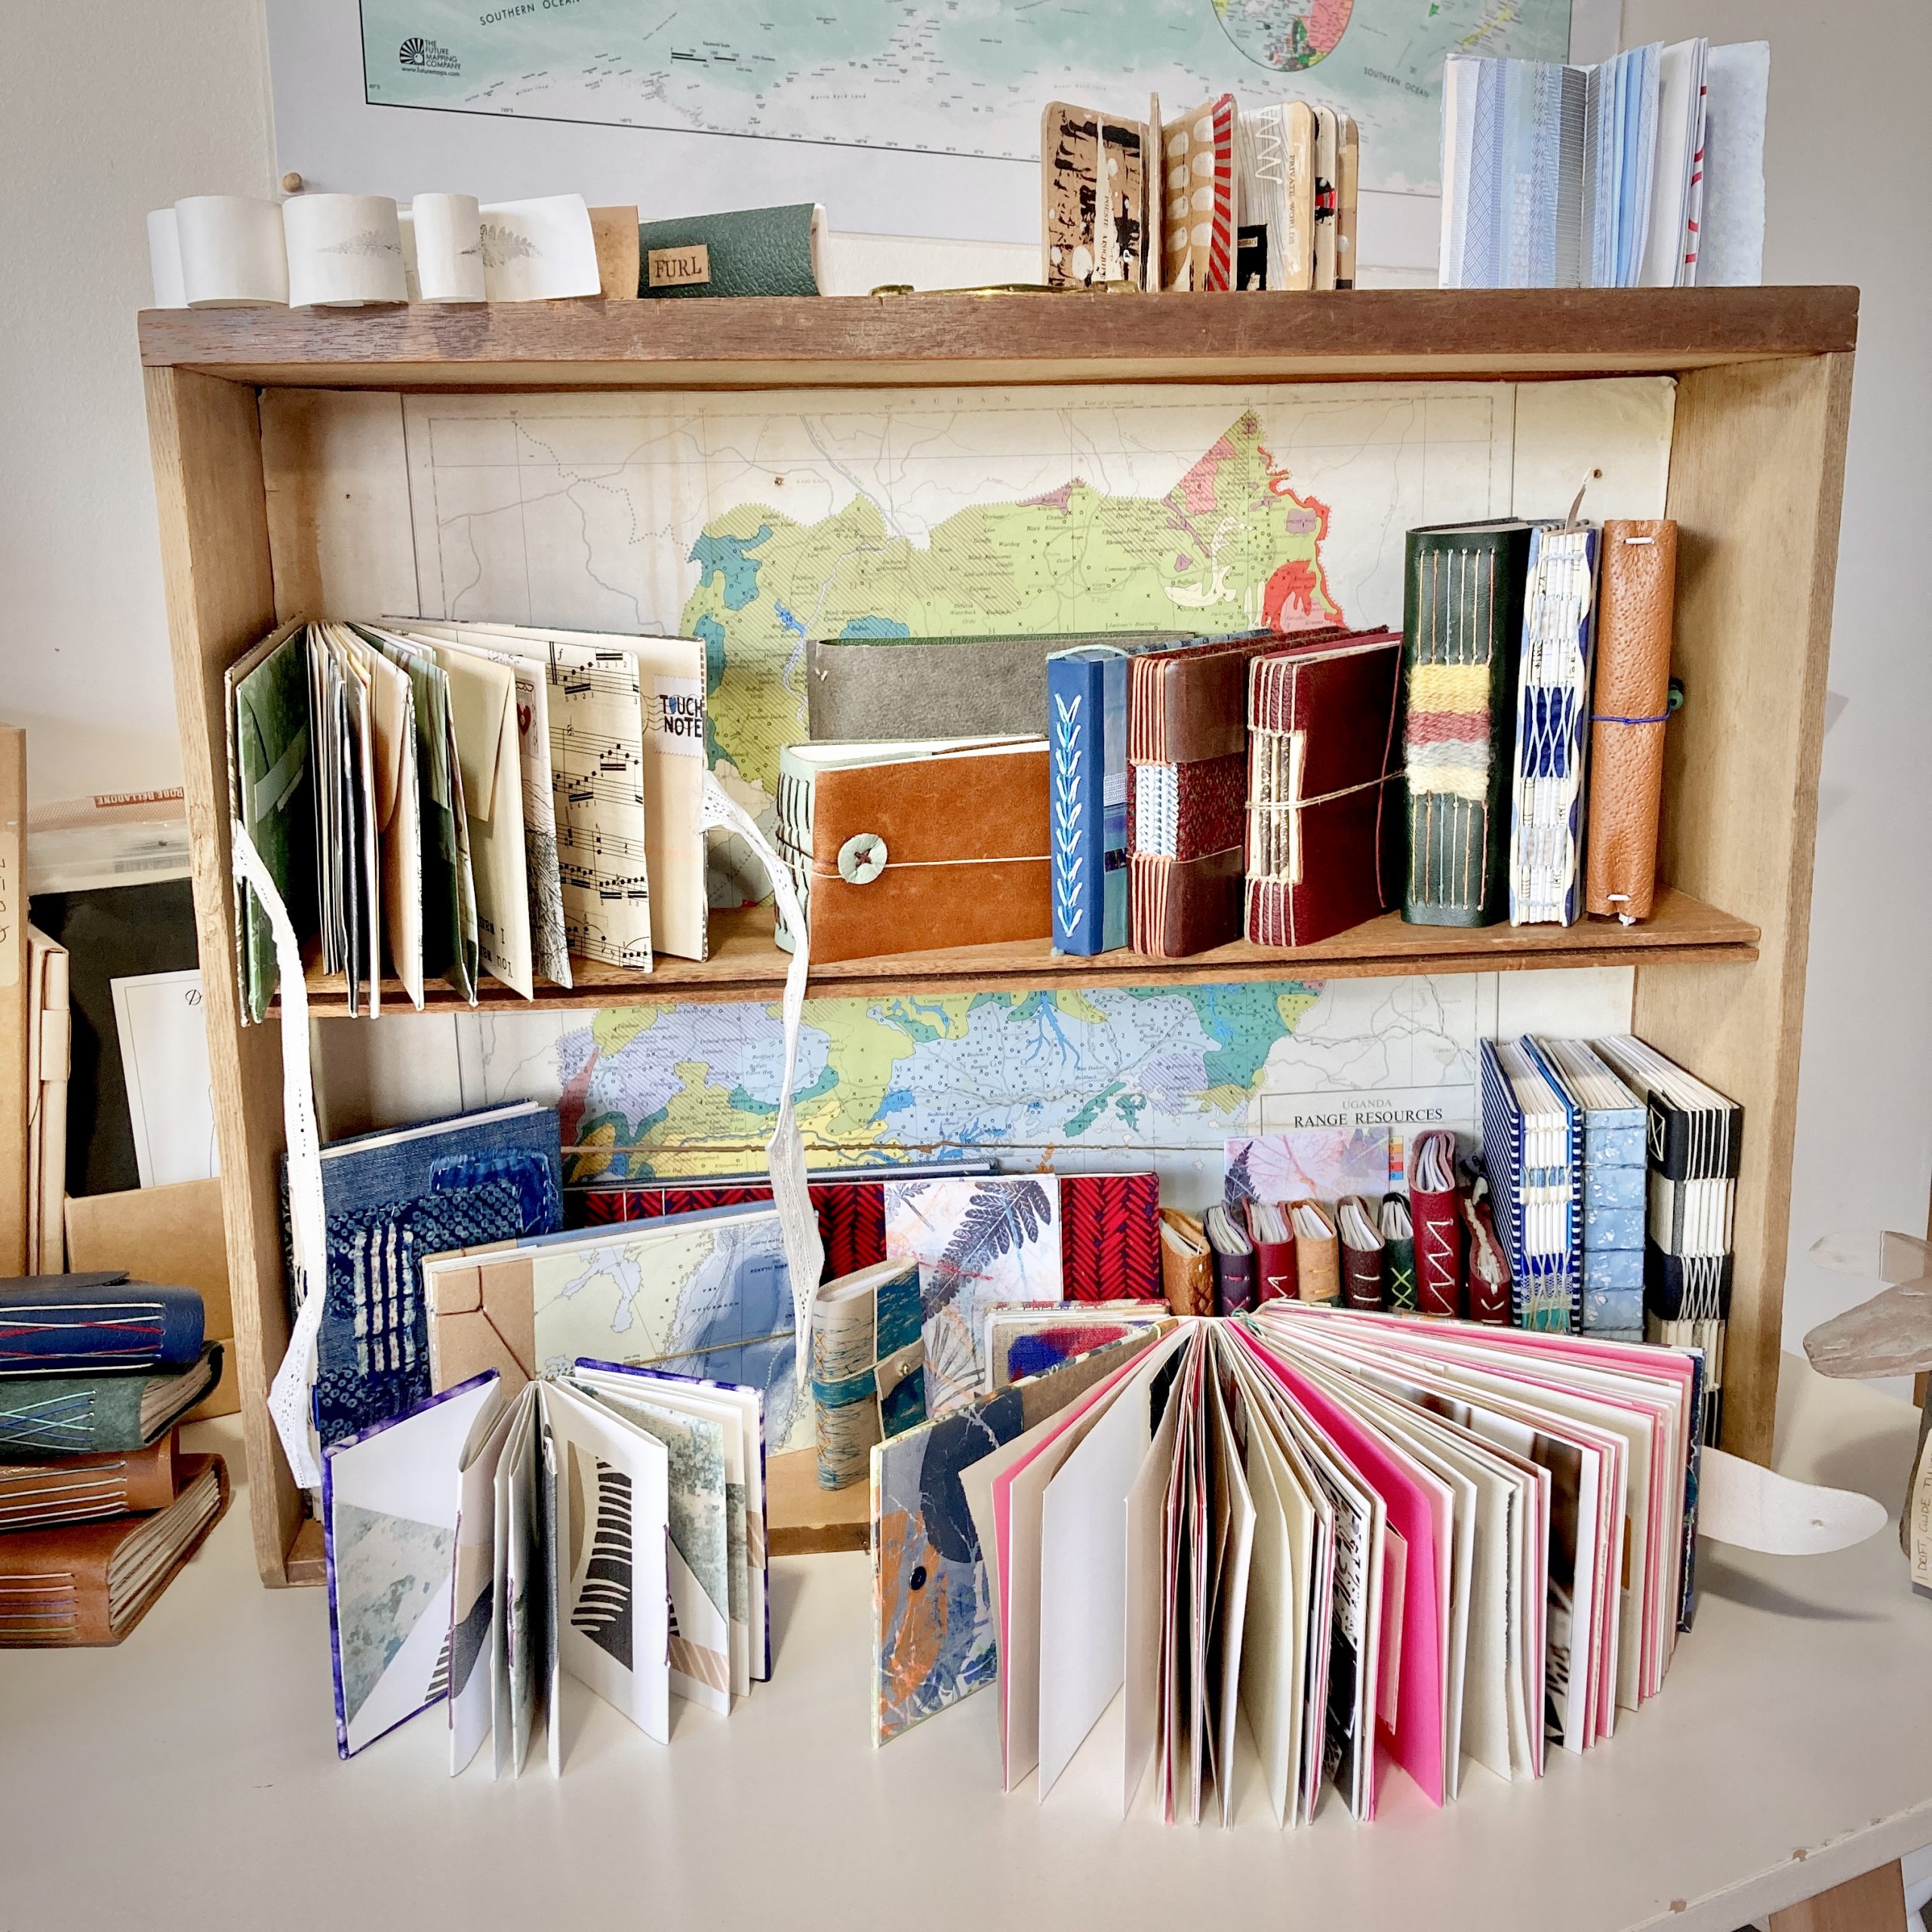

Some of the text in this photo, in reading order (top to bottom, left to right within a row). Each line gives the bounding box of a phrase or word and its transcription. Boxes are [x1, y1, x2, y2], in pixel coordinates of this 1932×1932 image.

[480, 4, 535, 26] SOUTHERN
[426, 54, 457, 63] MAPPING
[426, 60, 461, 69] COMPANY
[401, 66, 460, 77] www.futuremaps.com
[1364, 66, 1429, 98] SOUTHERN OCEAN
[654, 256, 702, 278] FURL
[664, 715, 703, 738] NOTE
[157, 787, 184, 800] ROBE
[496, 955, 514, 981] You
[1343, 1099, 1392, 1110] UGANDA
[1294, 1108, 1443, 1128] RANGE RESOURCES
[749, 1265, 773, 1274] ISLANDS
